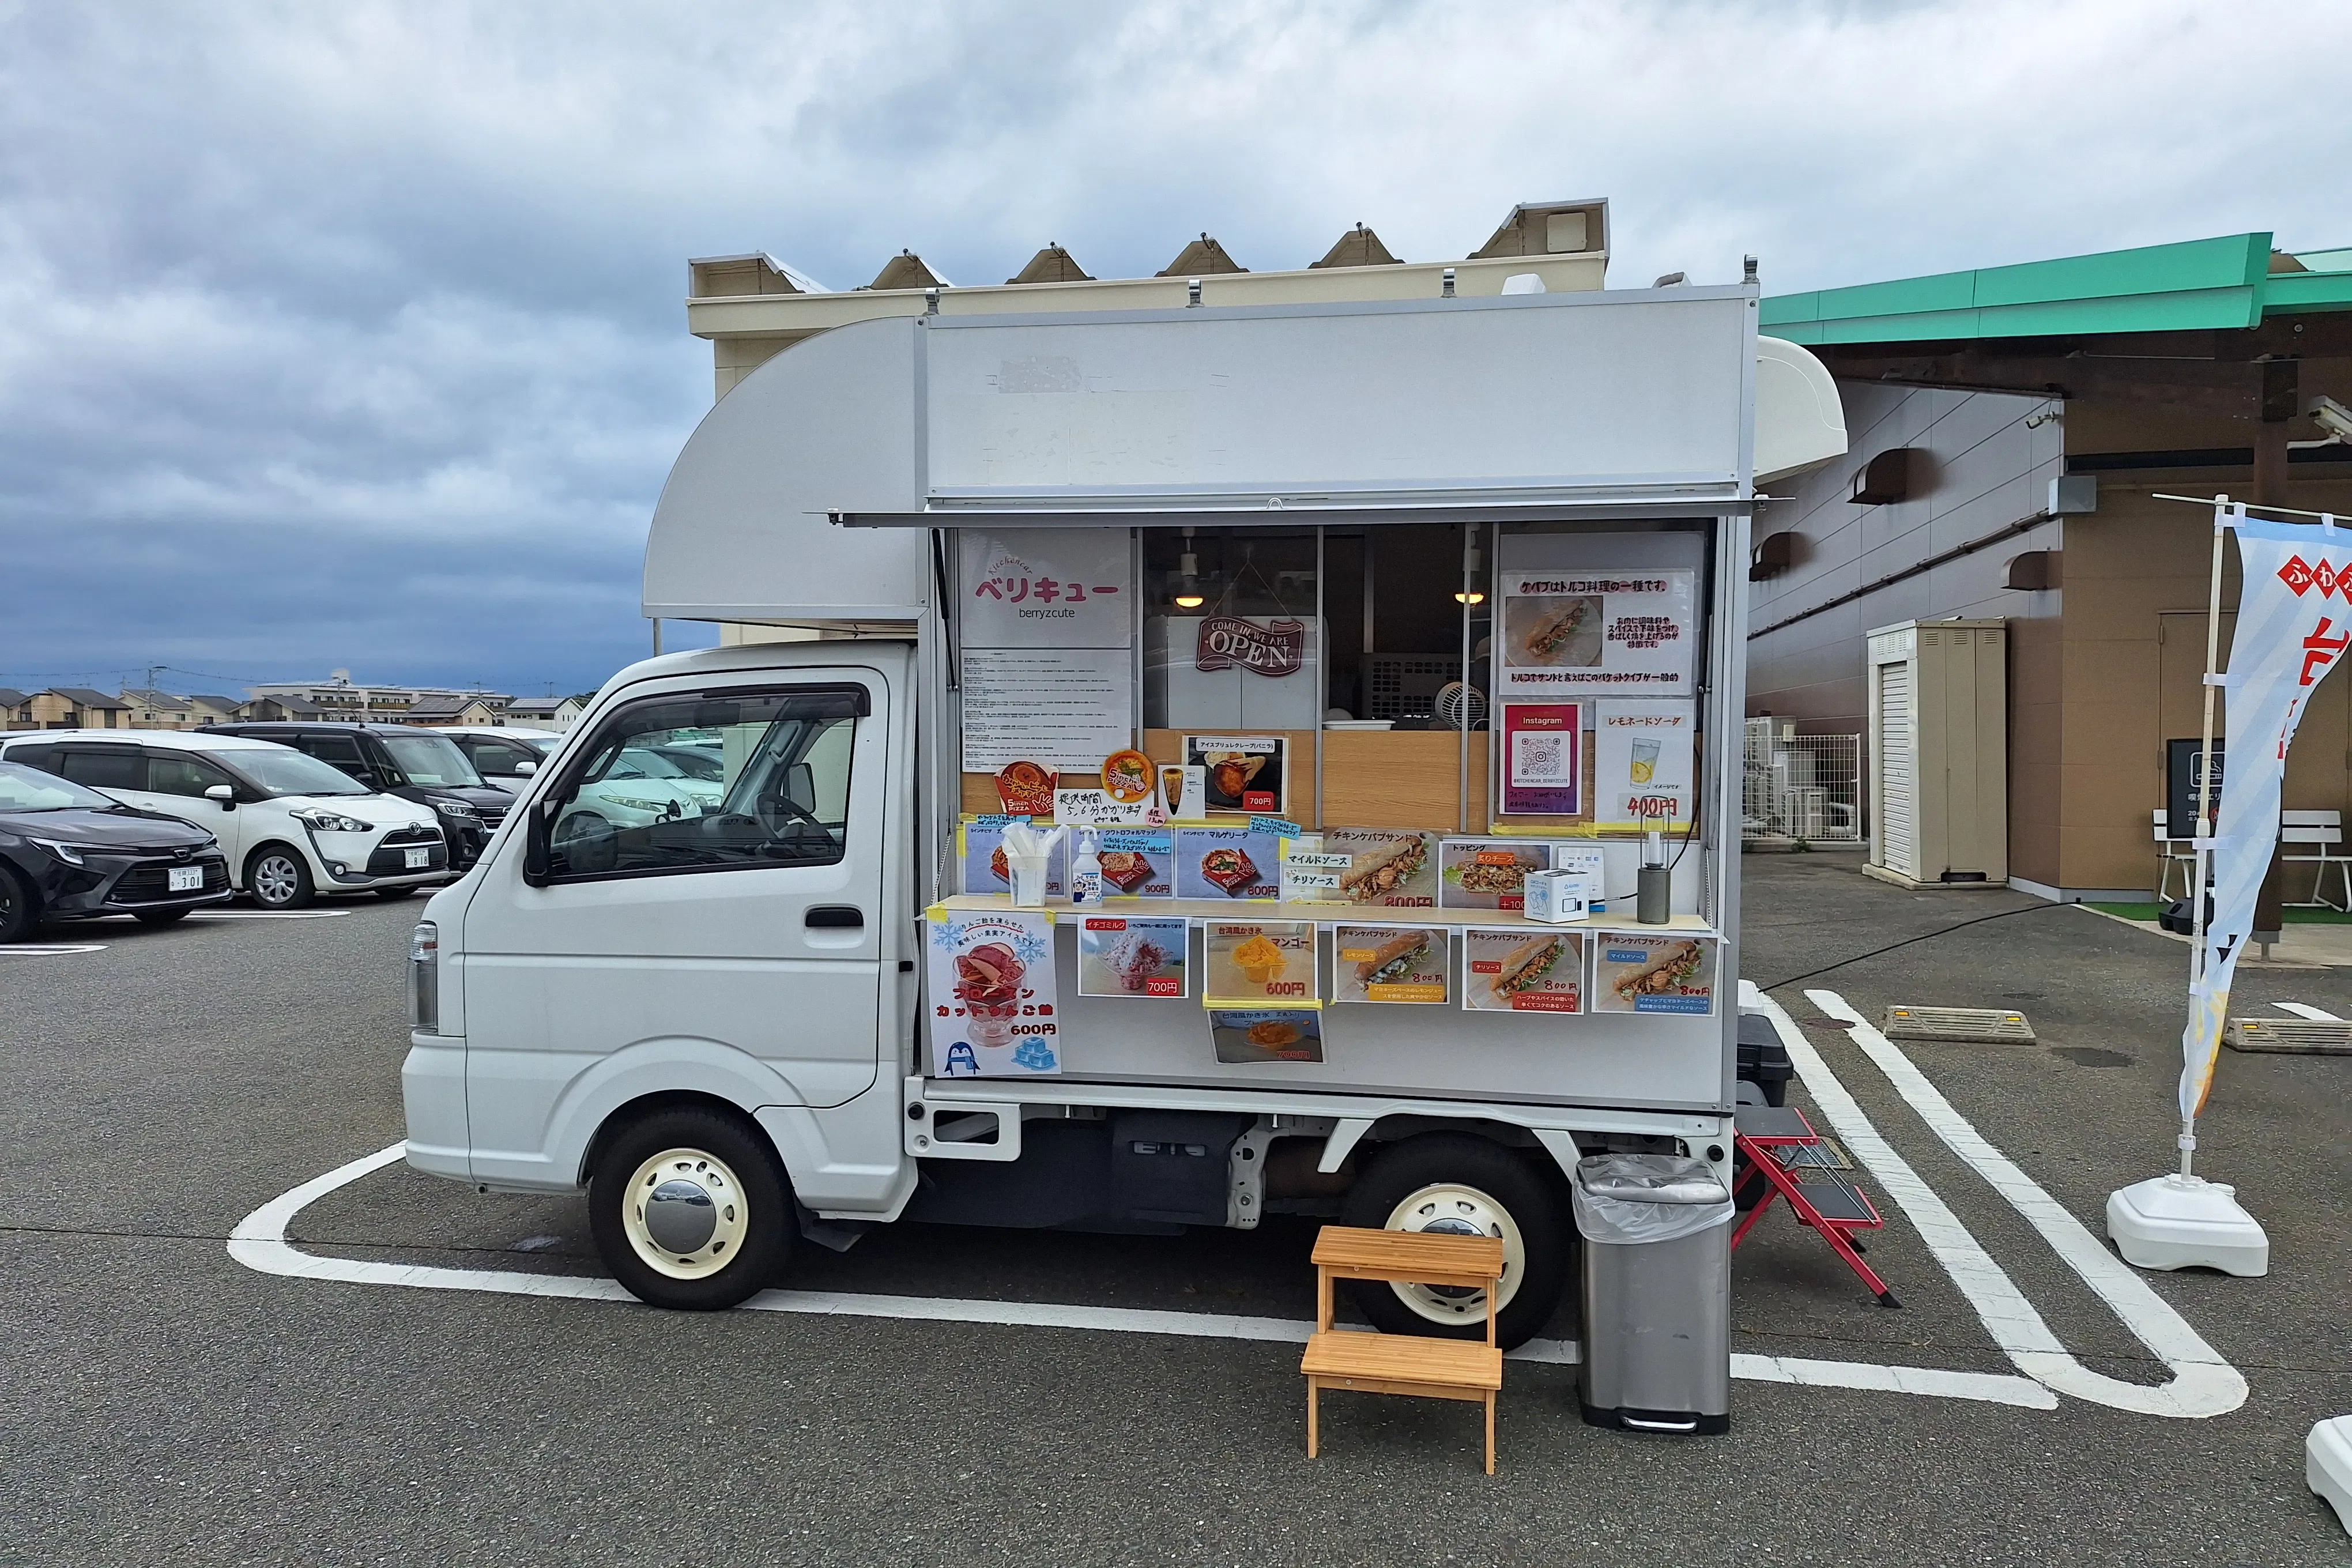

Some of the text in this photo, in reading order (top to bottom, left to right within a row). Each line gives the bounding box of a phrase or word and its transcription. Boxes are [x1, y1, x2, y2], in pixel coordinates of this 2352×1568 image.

[975, 577, 1119, 604] ベリキュー
[1019, 608, 1075, 620] berryzcute
[1211, 621, 1289, 646] COME IN, WE ARE
[1209, 630, 1290, 668] OPEN
[1522, 717, 1562, 725] Instagram
[1608, 717, 1682, 726] レモネードソーダ
[1109, 768, 1134, 783] 5inch
[1107, 777, 1132, 790] PIZZA
[1008, 798, 1029, 807] 5inch
[1058, 793, 1102, 805] 提供時間
[1249, 797, 1271, 806] 700円
[1627, 797, 1678, 816] 400円
[1208, 831, 1249, 839] マルゲリータ
[1333, 831, 1412, 843] チキンケバブサンド
[1453, 844, 1486, 852] トッピング
[1288, 854, 1348, 865] マイルドソース
[1477, 854, 1514, 863] 炙りチーズ
[1292, 875, 1335, 885] チリソース
[1145, 884, 1170, 893] 900円
[1247, 885, 1279, 897] 800円
[1384, 895, 1433, 907] 800円
[1271, 937, 1310, 947] マンゴー
[1472, 934, 1532, 942] チキンケバブサンド
[1605, 937, 1669, 946] チキンケバブサンド
[1412, 973, 1443, 983] 800円
[1147, 982, 1177, 993] 700円
[1266, 982, 1305, 996] 600円
[1544, 979, 1577, 990] 800円
[1679, 985, 1710, 997] 800円
[1011, 1023, 1057, 1036] 600円
